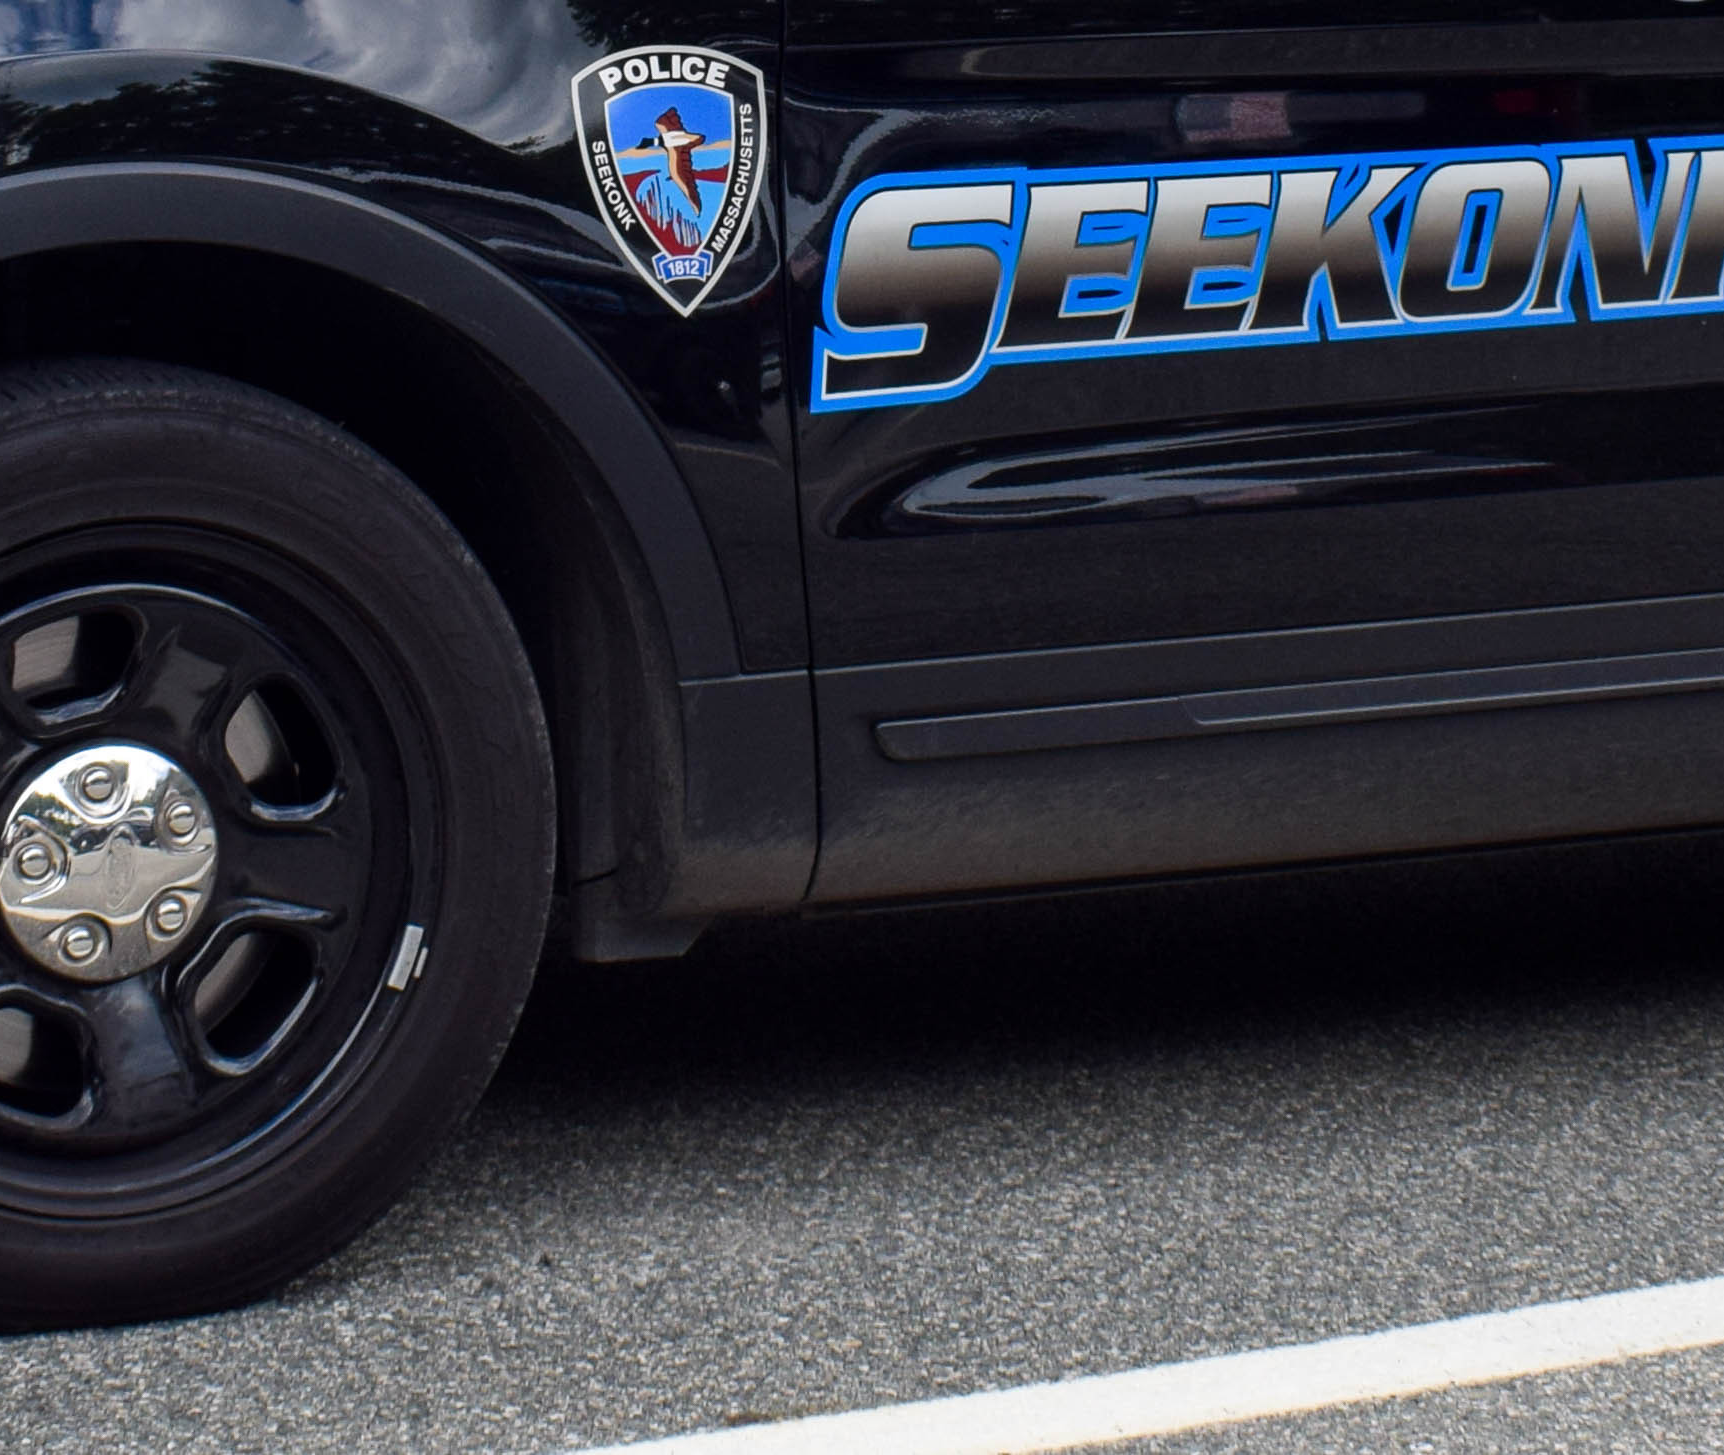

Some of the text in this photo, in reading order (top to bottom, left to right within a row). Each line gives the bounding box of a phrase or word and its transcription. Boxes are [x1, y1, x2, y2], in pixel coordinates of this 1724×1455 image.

[598, 54, 731, 94] POLICE
[591, 140, 637, 233] SEEKONK
[710, 103, 753, 253] MASSACHUSETTS
[666, 258, 701, 277] 1812
